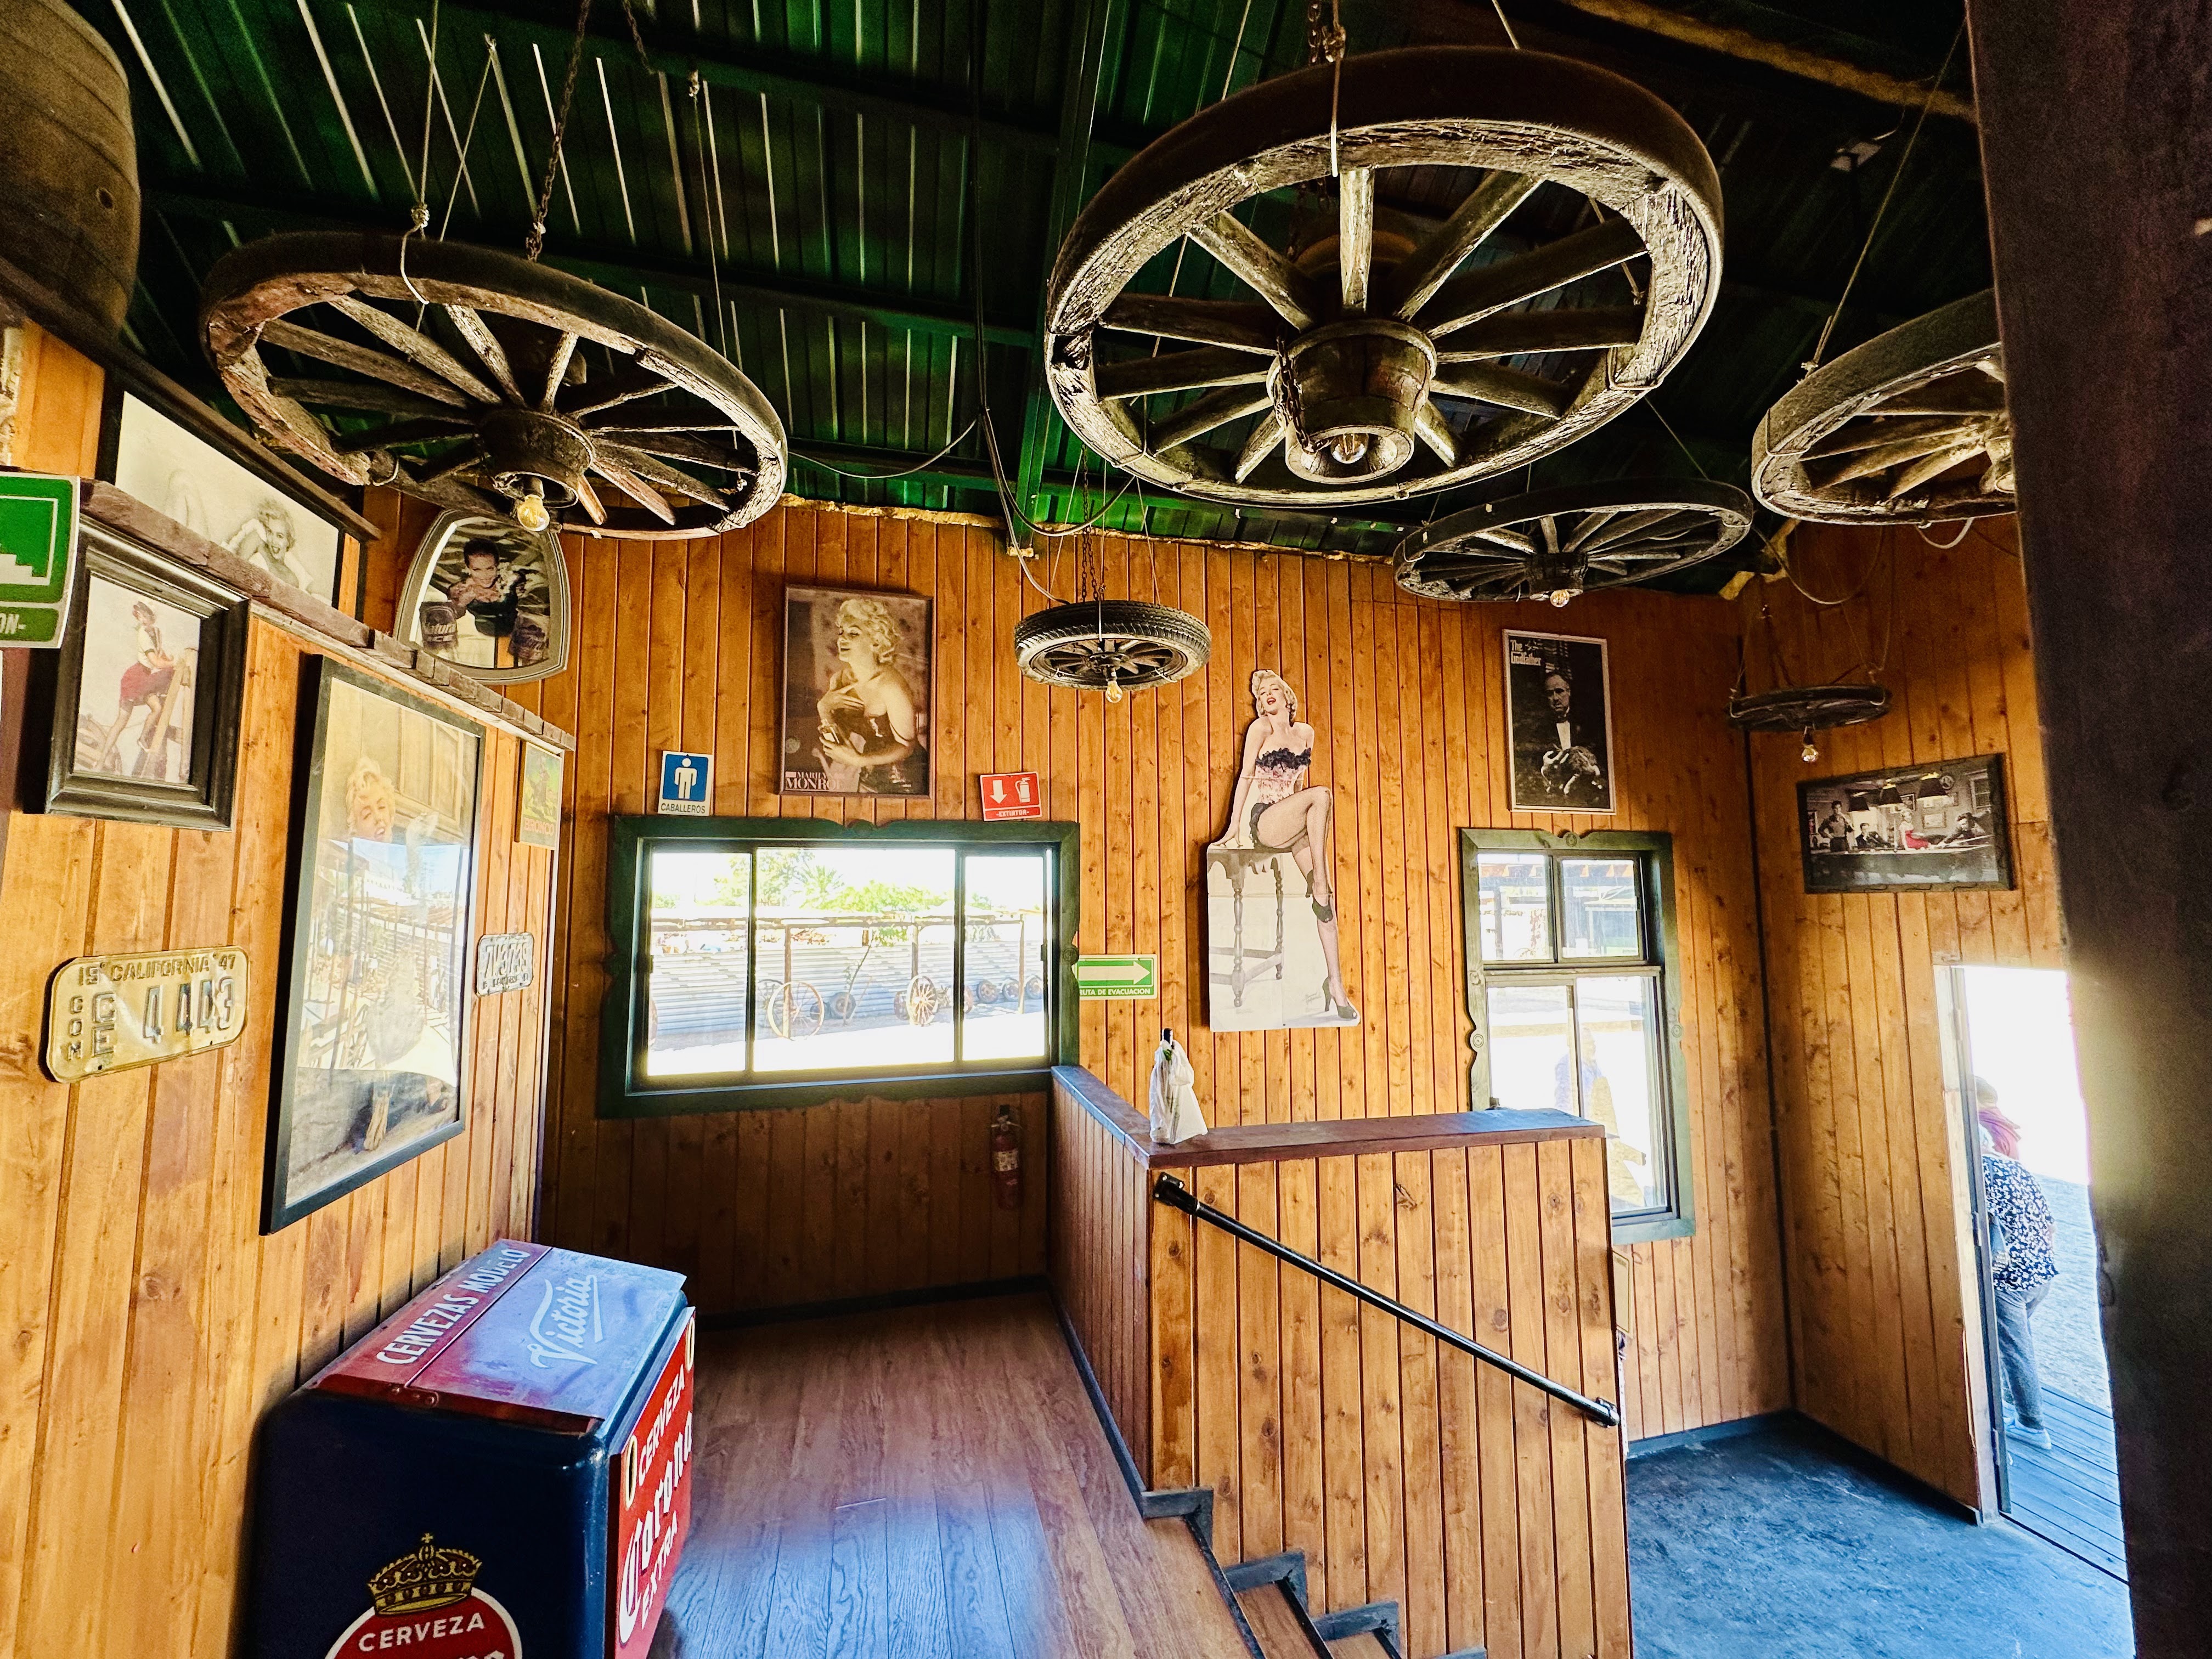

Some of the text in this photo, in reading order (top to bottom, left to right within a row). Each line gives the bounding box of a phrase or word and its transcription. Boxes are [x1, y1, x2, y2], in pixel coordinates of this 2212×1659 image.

[1510, 640, 1523, 652] The
[524, 817, 554, 836] BRONCO
[661, 803, 706, 814] CABALLEROS
[110, 957, 210, 981] CALIFORNIA
[220, 954, 236, 970] 47
[376, 1249, 531, 1364] CERVEZAS MODELO
[527, 1274, 603, 1368] Victoria
[639, 1364, 685, 1487] CERVEZA
[619, 1410, 692, 1644] Corona
[641, 1510, 678, 1630] EXTRA
[358, 1612, 486, 1652] CERVEZA
